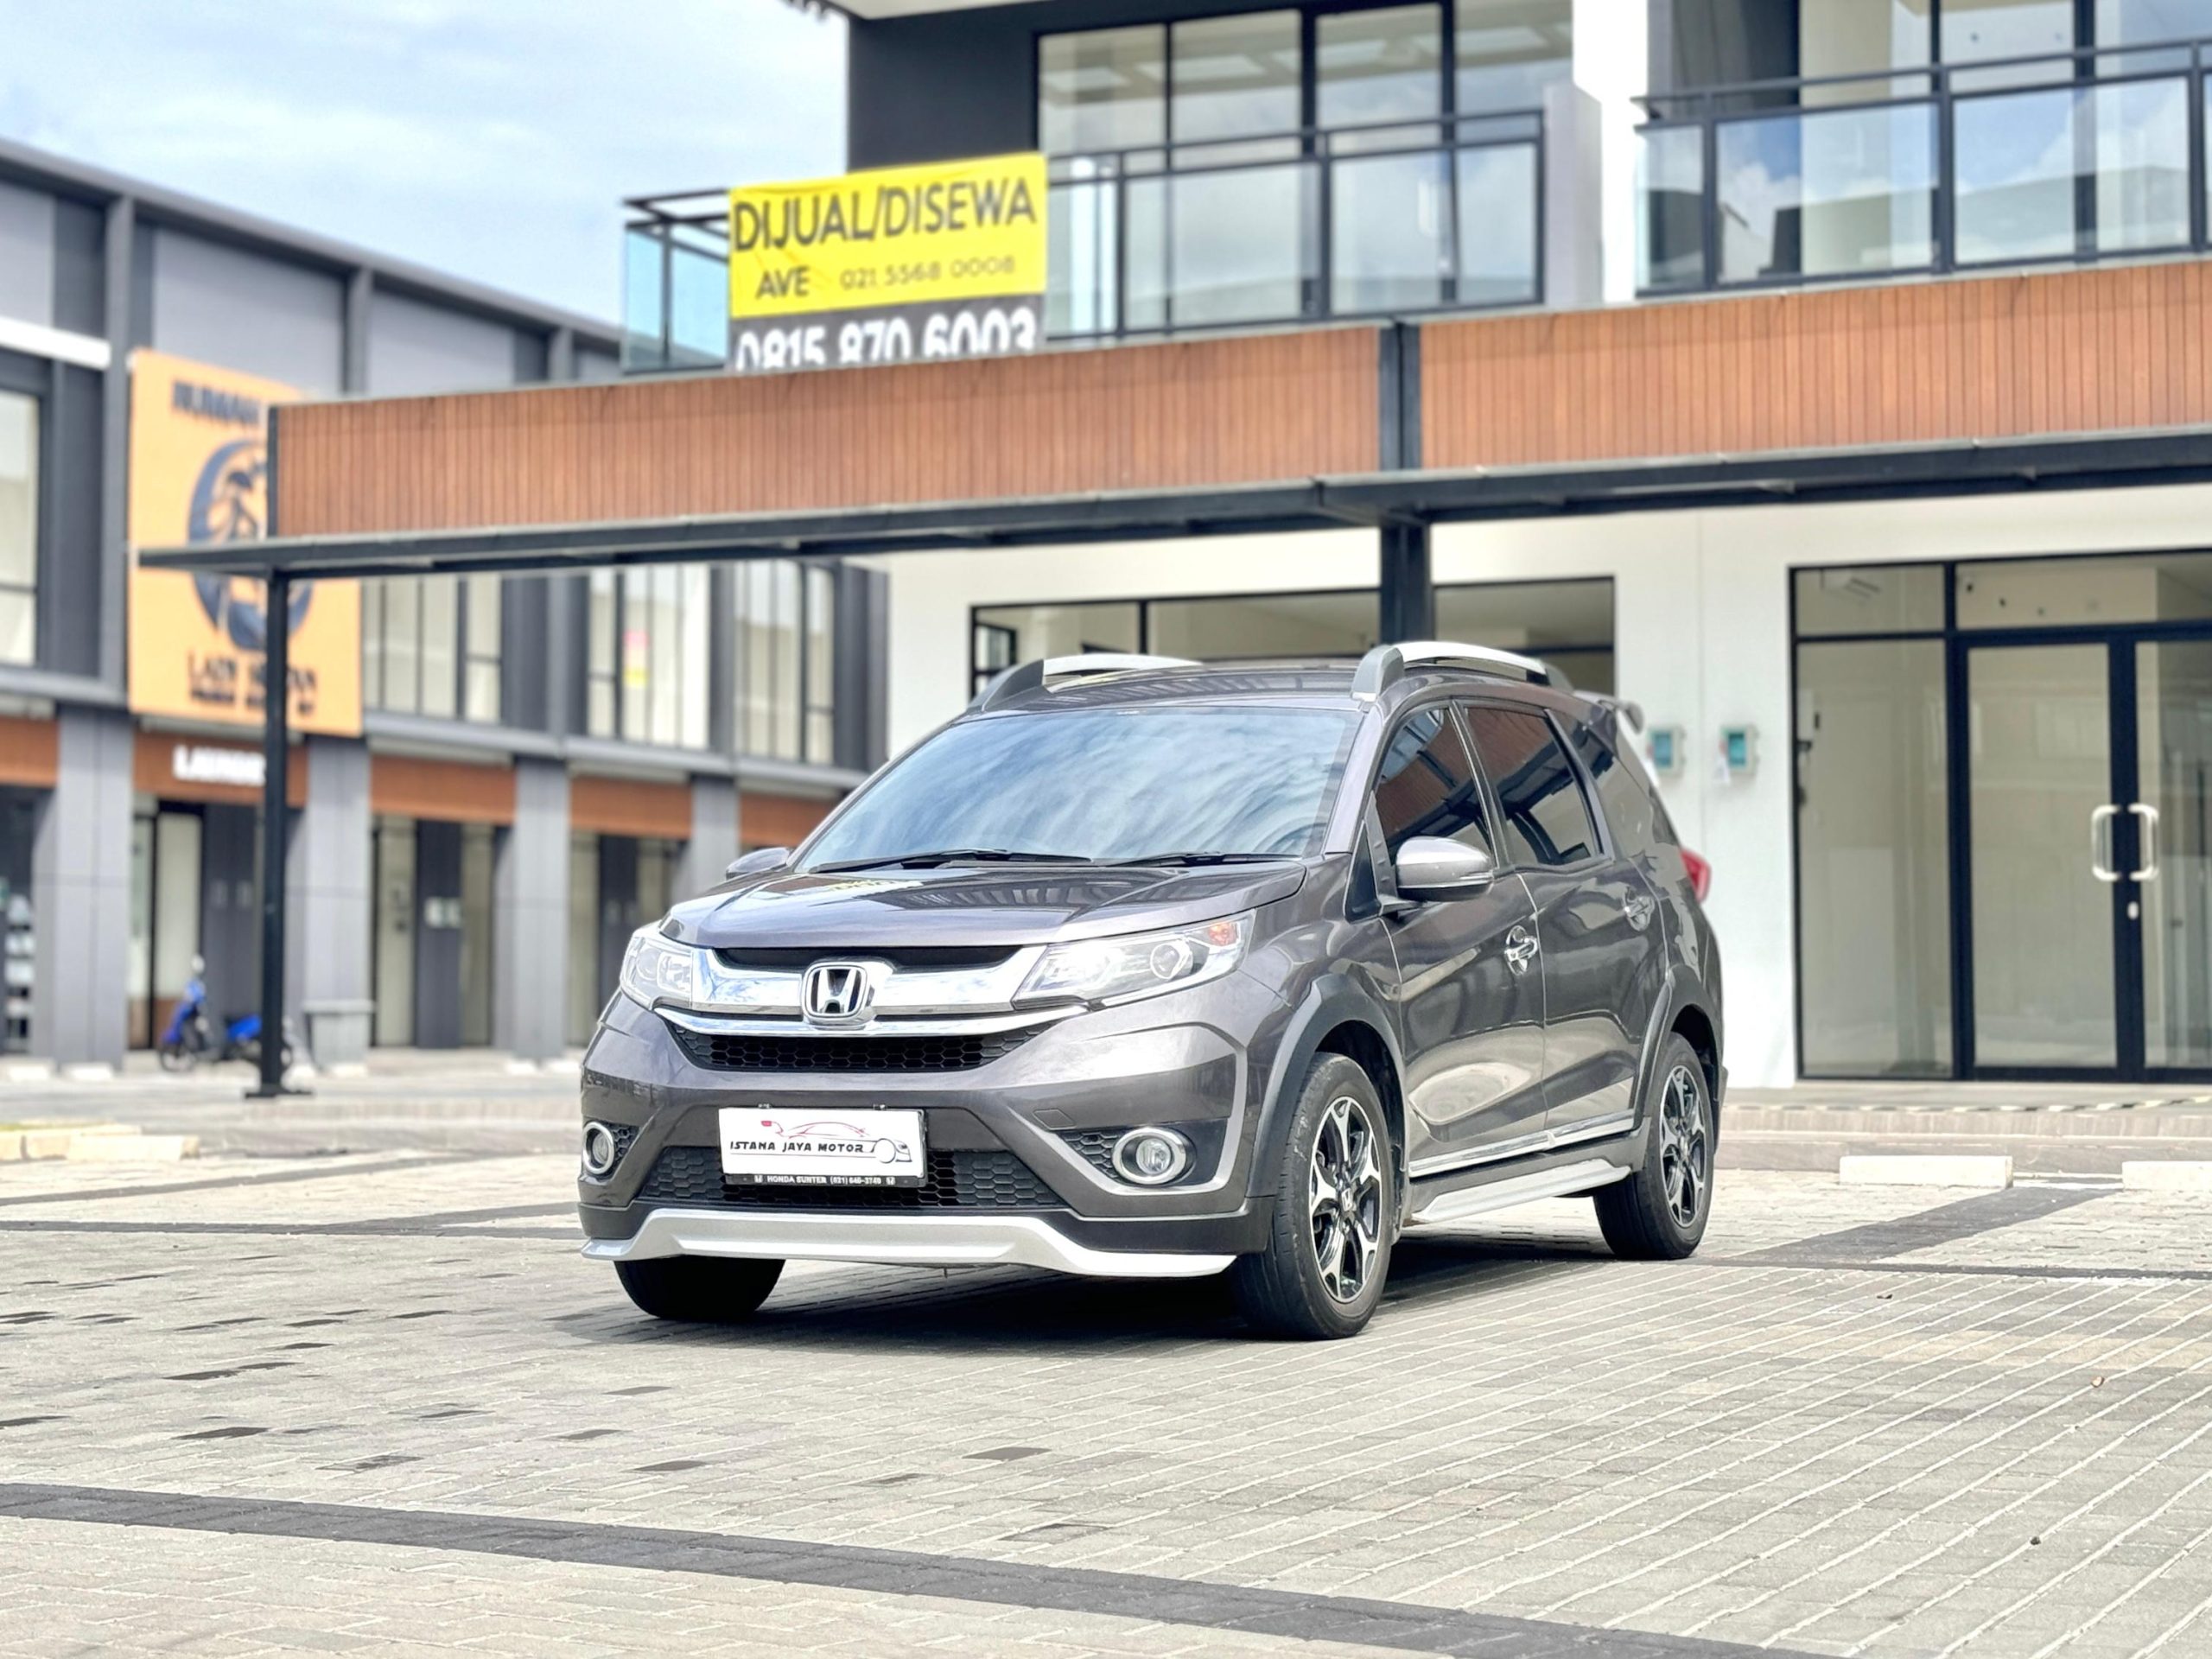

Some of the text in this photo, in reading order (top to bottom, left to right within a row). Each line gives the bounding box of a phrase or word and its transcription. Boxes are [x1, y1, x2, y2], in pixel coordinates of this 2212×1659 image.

[734, 176, 1037, 252] DIJUAL/DISEWA
[755, 256, 1016, 299] AVE 021 5568 0008
[730, 1141, 864, 1153] ISTANA JAYA MOTOR
[767, 1175, 795, 1184] HONDA
